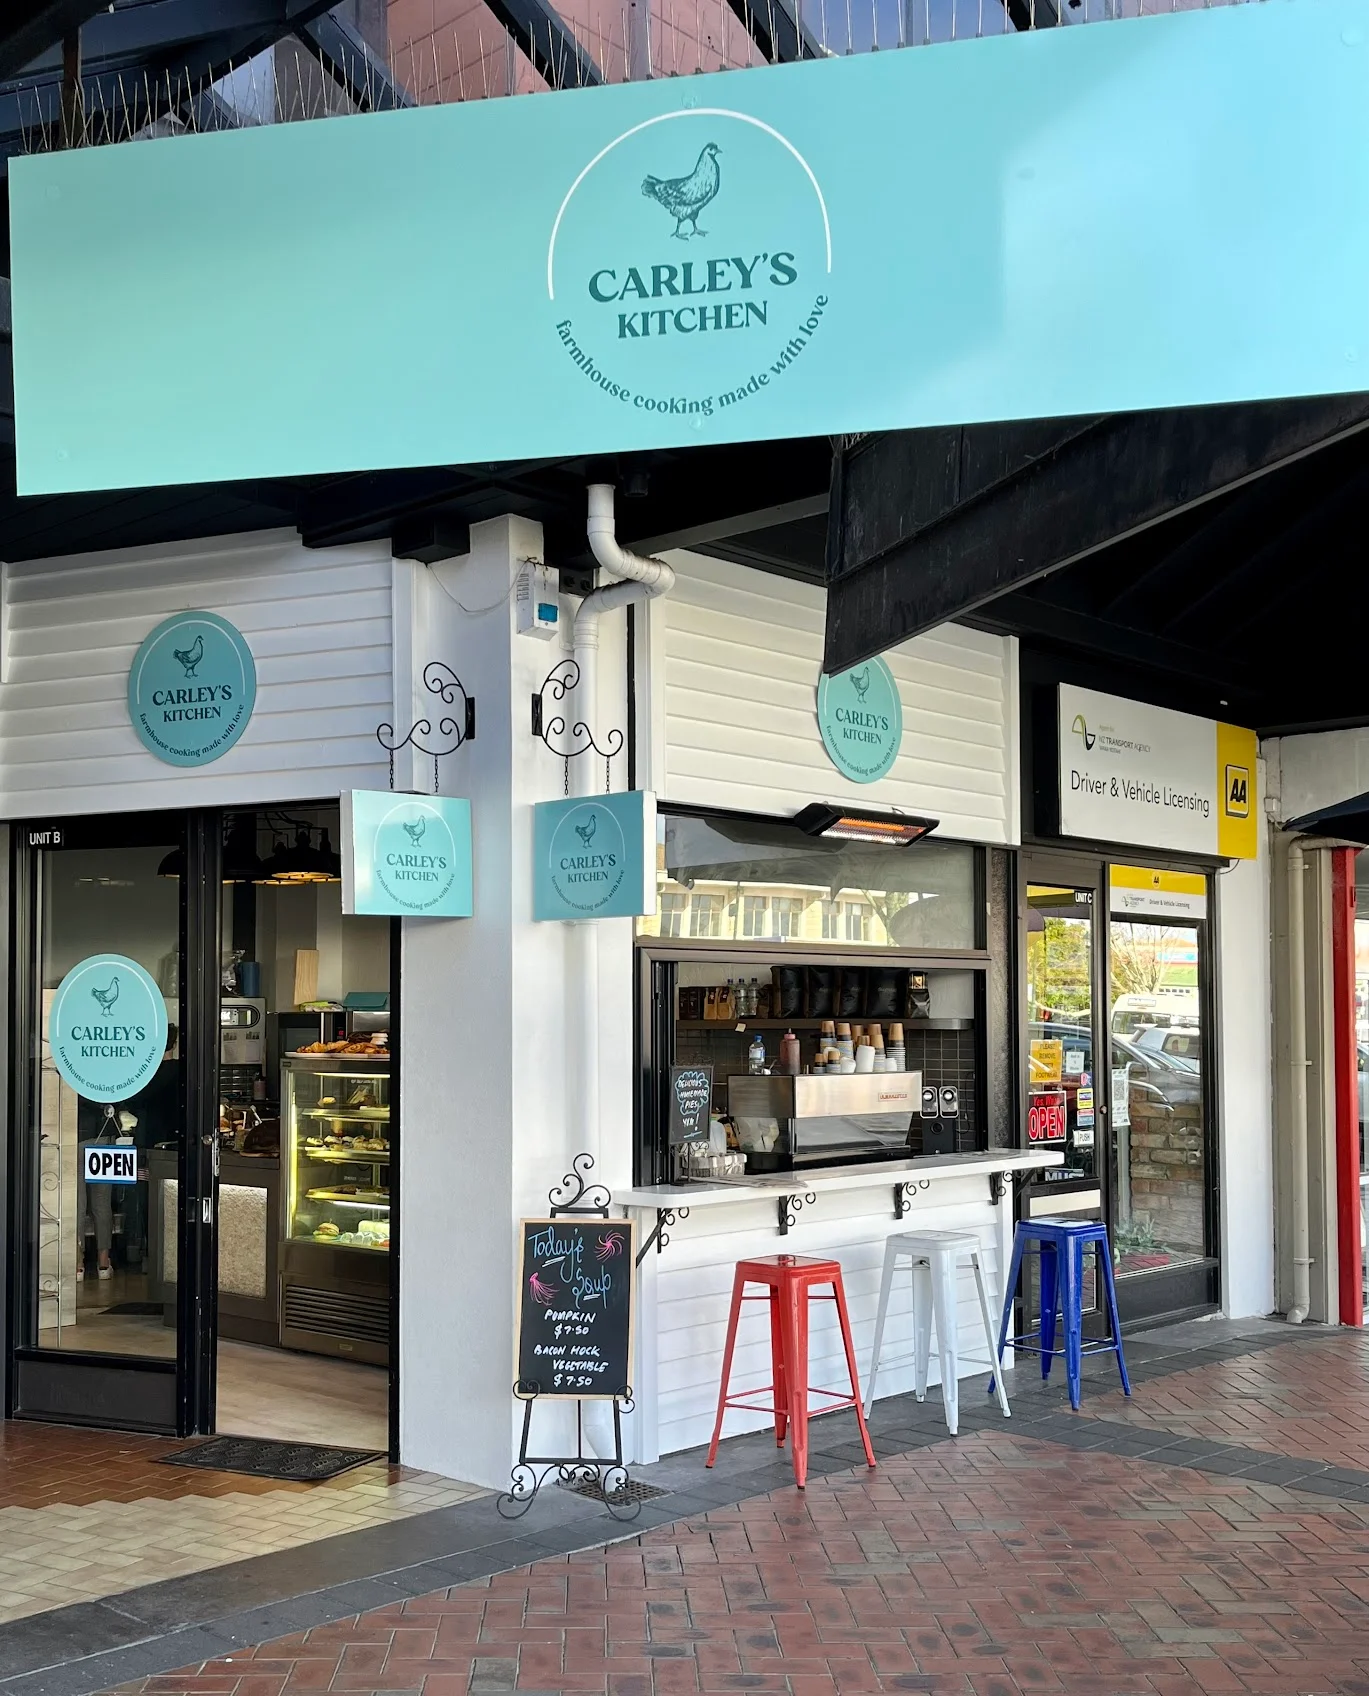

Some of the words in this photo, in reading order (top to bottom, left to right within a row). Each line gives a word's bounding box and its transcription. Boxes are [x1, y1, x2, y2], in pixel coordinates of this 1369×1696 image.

[588, 252, 798, 303] CARLEY'S
[617, 300, 768, 339] KITCHEN
[556, 319, 630, 402] farmhouse
[633, 395, 714, 416] cooking
[718, 373, 771, 408] made
[769, 337, 807, 376] with
[806, 294, 829, 339] love
[152, 684, 233, 706] CARLEY'S
[163, 706, 221, 722] KITCHEN
[835, 707, 889, 731] CARLEY'S
[140, 713, 168, 751] farmhouse
[169, 747, 201, 758] cooking
[201, 738, 222, 754] made
[221, 722, 236, 741] with
[233, 704, 245, 725] love
[843, 727, 882, 745] KITCHEN
[1071, 769, 1107, 796] Driver
[1110, 777, 1119, 798] &
[1122, 778, 1160, 805] Vehicle
[1163, 786, 1210, 818] Licensing
[1229, 778, 1247, 804] AA
[29, 832, 51, 846] UNIT
[53, 831, 61, 844] B
[386, 853, 447, 869] CARLEY'S
[560, 853, 616, 870] CARLEY'S
[395, 870, 439, 882] KITCHEN
[567, 871, 609, 883] KITCHEN
[1075, 892, 1087, 903] UNIT
[1087, 893, 1093, 903] C
[71, 1026, 146, 1041] CARLEY'S
[81, 1045, 135, 1057] KITCHEN
[59, 1046, 85, 1085] farmhouse
[85, 1081, 115, 1093] cooking
[116, 1077, 135, 1090] made
[134, 1063, 149, 1081] with
[145, 1046, 157, 1064] love
[685, 1100, 698, 1109] PIES
[1028, 1106, 1065, 1140] OPEN
[1080, 1133, 1090, 1142] PUSH
[87, 1151, 134, 1178] OPEN
[528, 1226, 584, 1283] Today's
[572, 1265, 612, 1309] Soup
[544, 1309, 596, 1323] PUMPKIN
[533, 1344, 567, 1356] BACON
[570, 1345, 601, 1357] HOCK
[552, 1359, 609, 1373] VEGETABLE
